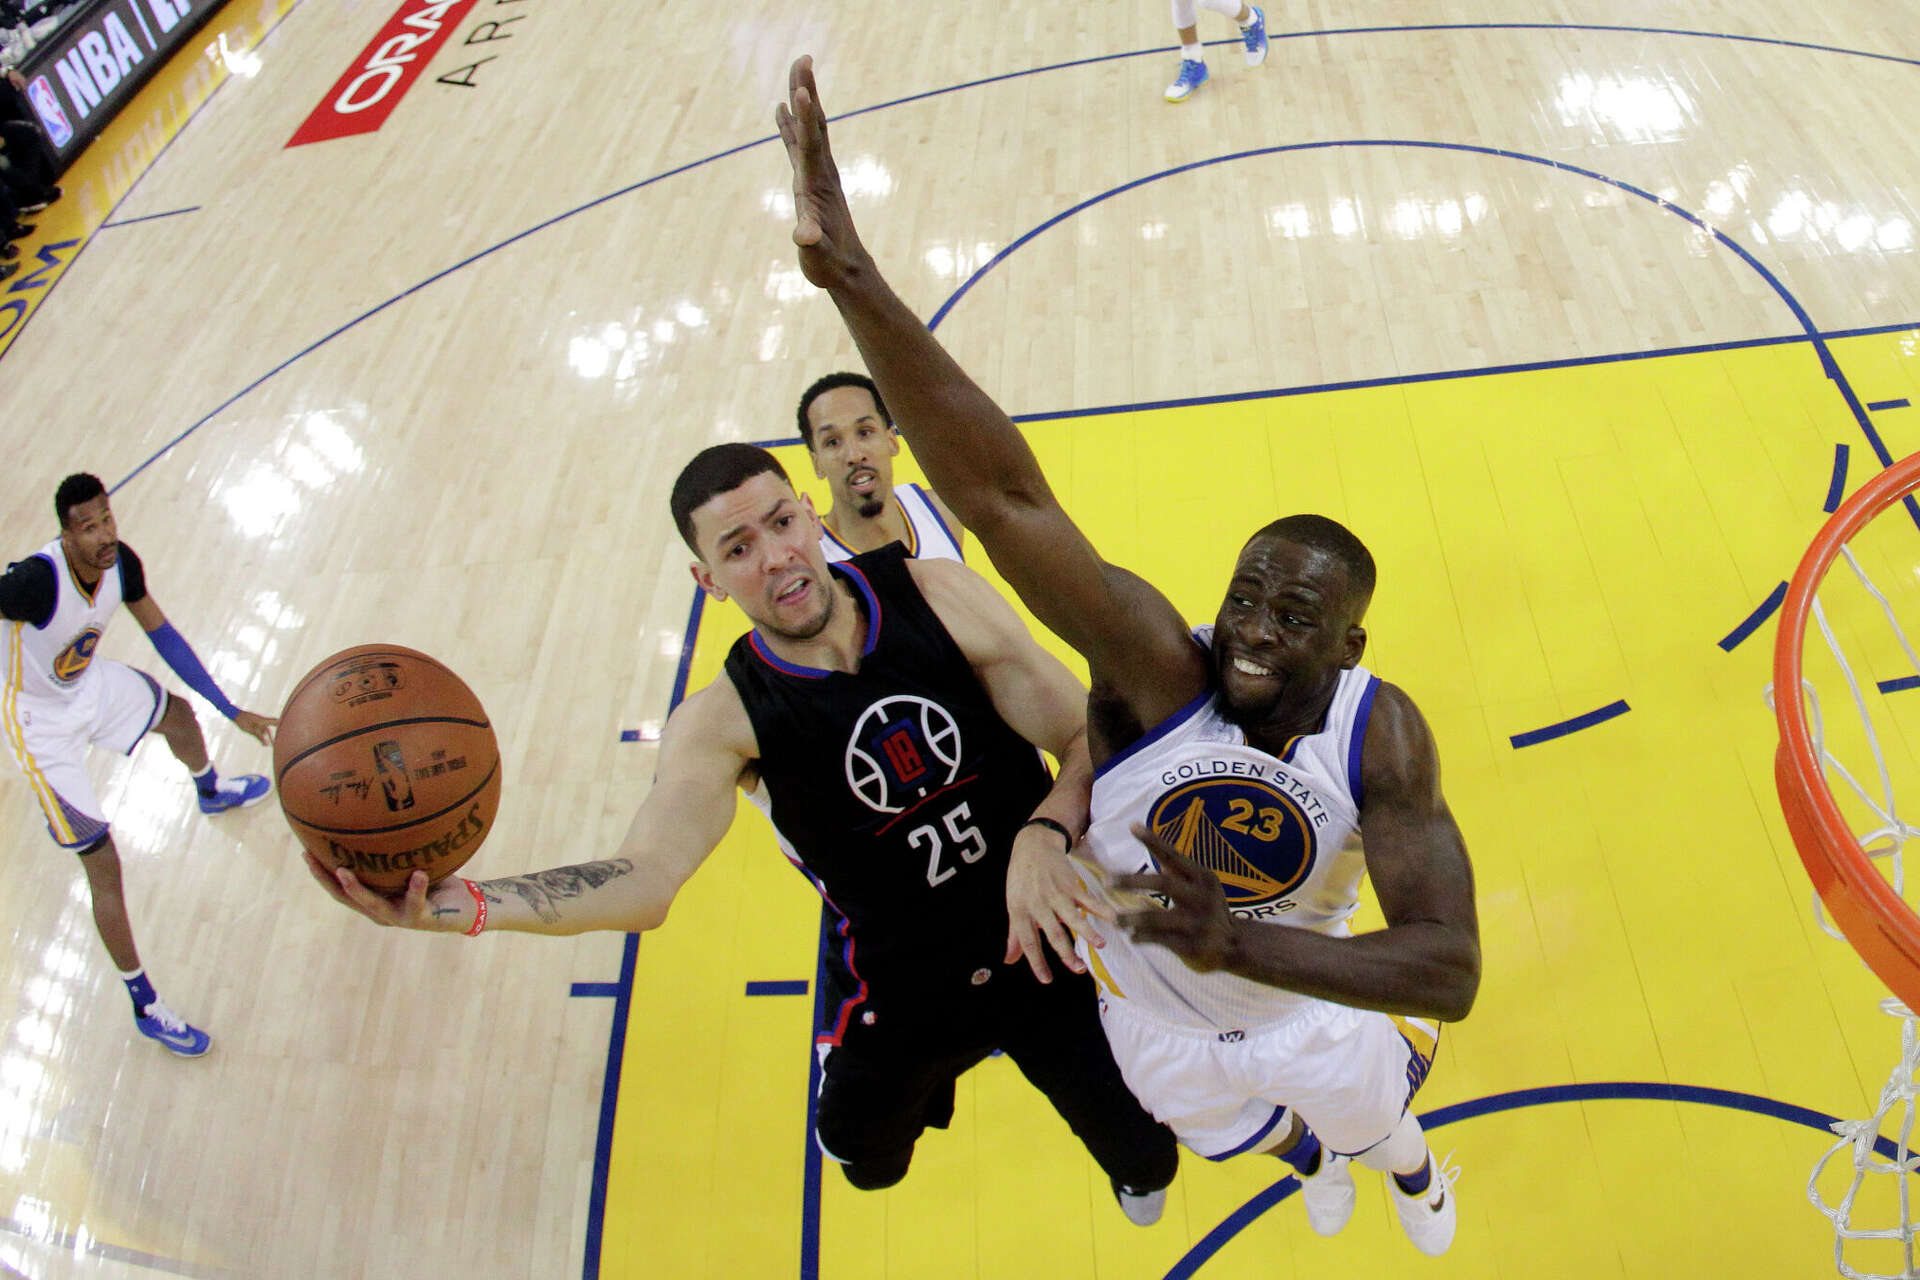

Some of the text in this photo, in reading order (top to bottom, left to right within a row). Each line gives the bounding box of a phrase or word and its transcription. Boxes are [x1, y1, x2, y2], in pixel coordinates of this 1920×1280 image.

[54, 11, 144, 120] NBA
[334, 0, 462, 114] ORA
[436, 0, 528, 87] AR
[327, 801, 484, 873] SPALDING
[1162, 761, 1329, 828] GOLDEN STATE
[1220, 798, 1284, 842] 23
[907, 801, 987, 888] 25
